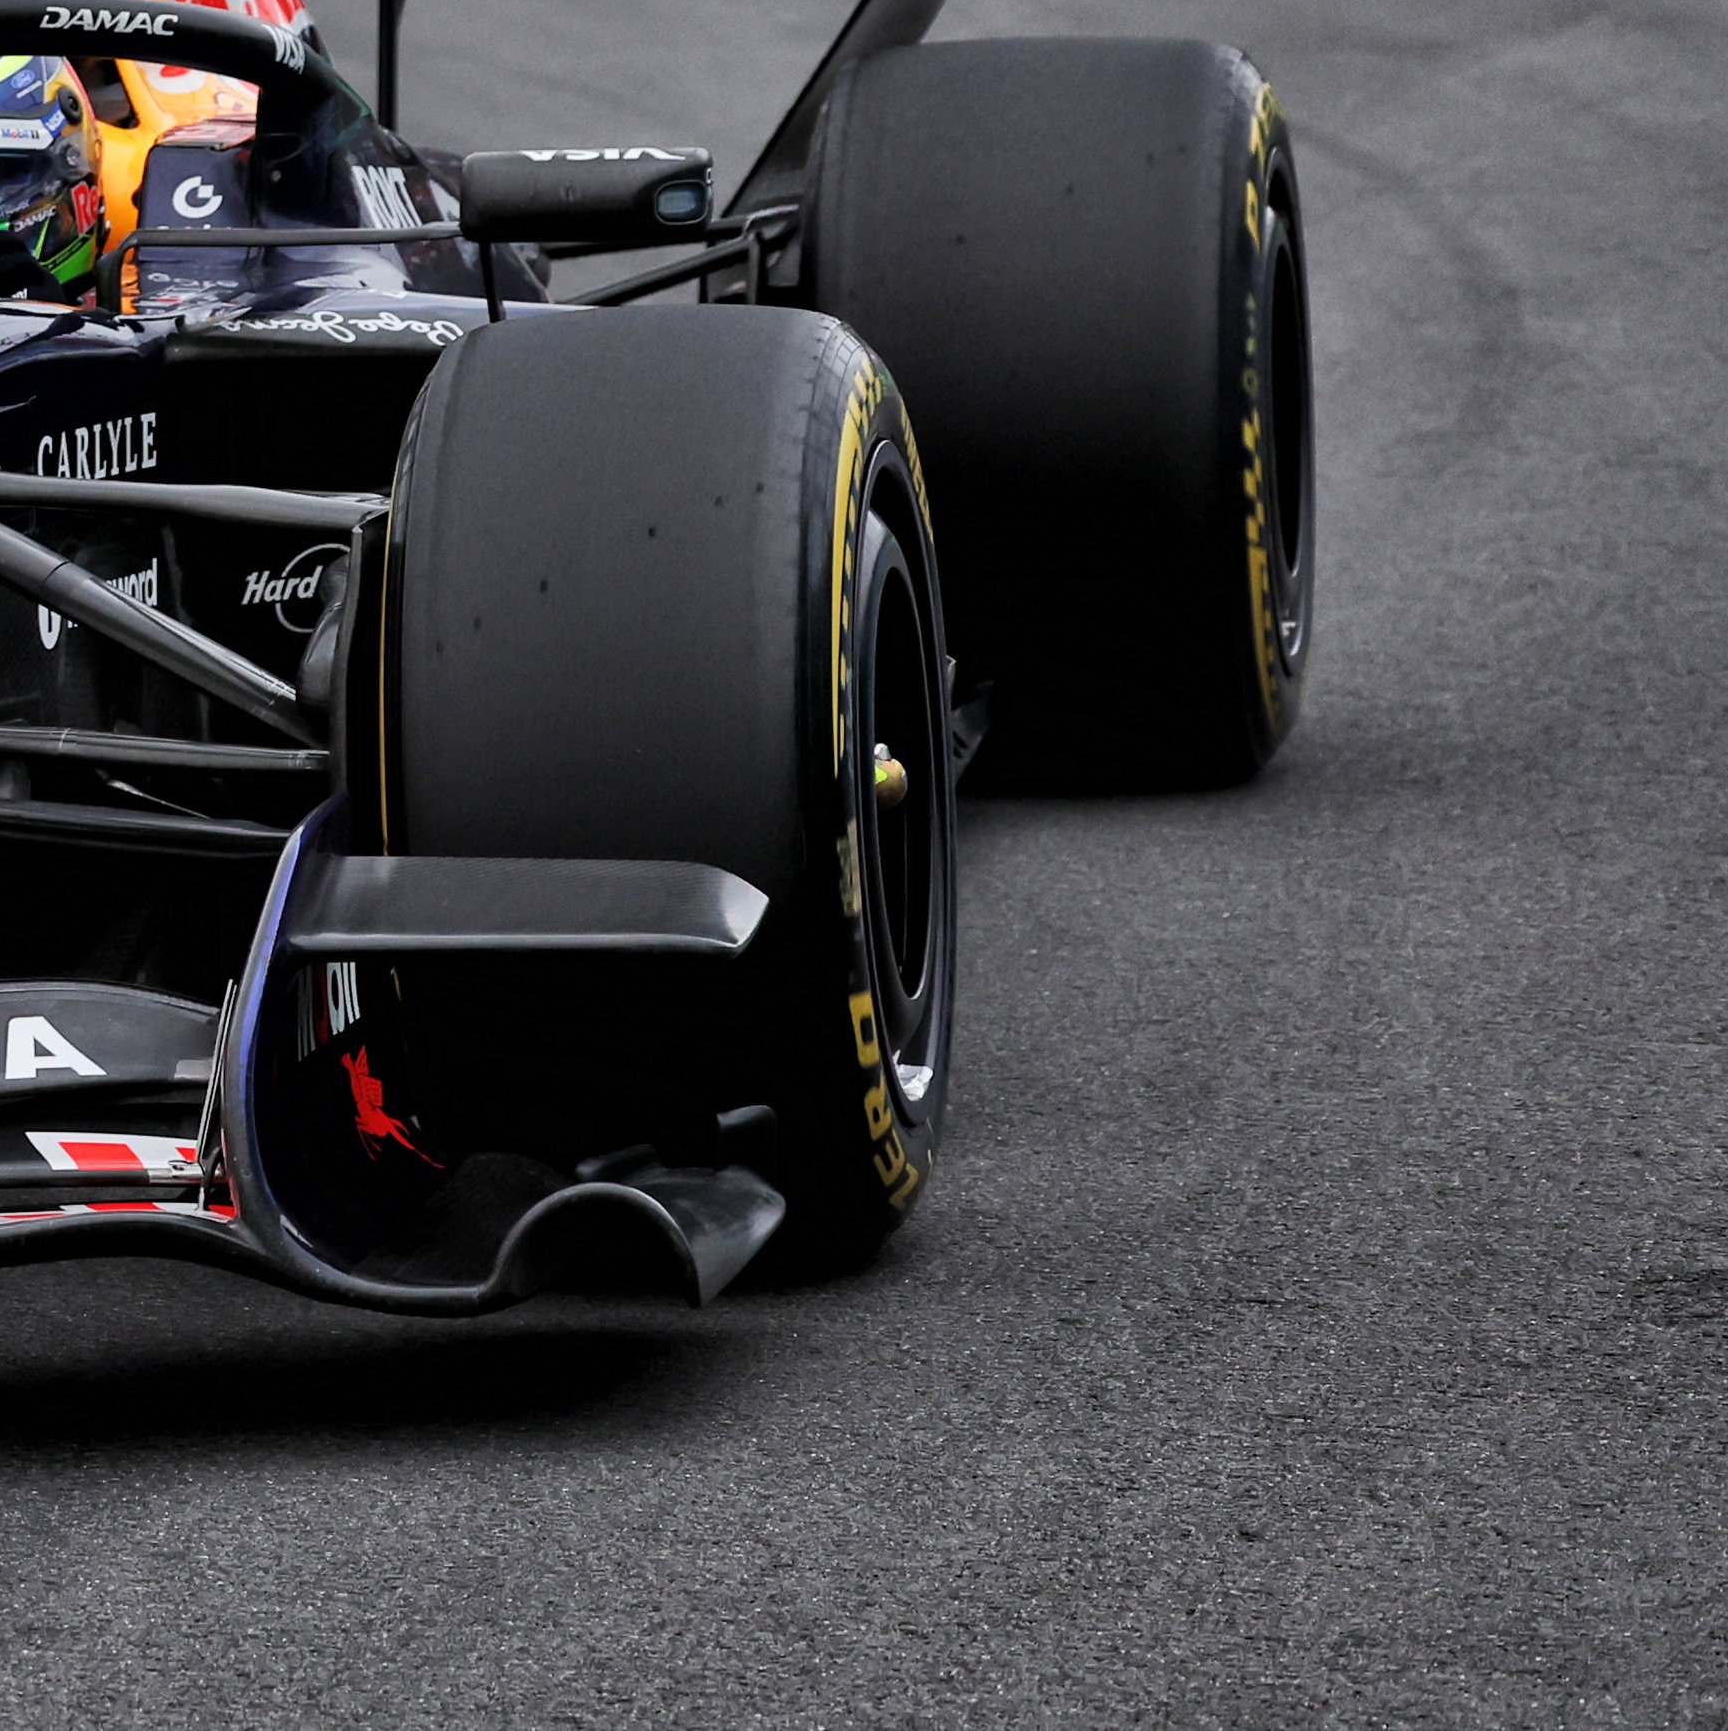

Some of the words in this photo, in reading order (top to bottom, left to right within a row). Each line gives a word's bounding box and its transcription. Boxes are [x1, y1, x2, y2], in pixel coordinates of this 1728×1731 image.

[40, 6, 178, 36] DAMAC
[37, 412, 157, 480] CARLYLE
[241, 564, 324, 606] Hard
